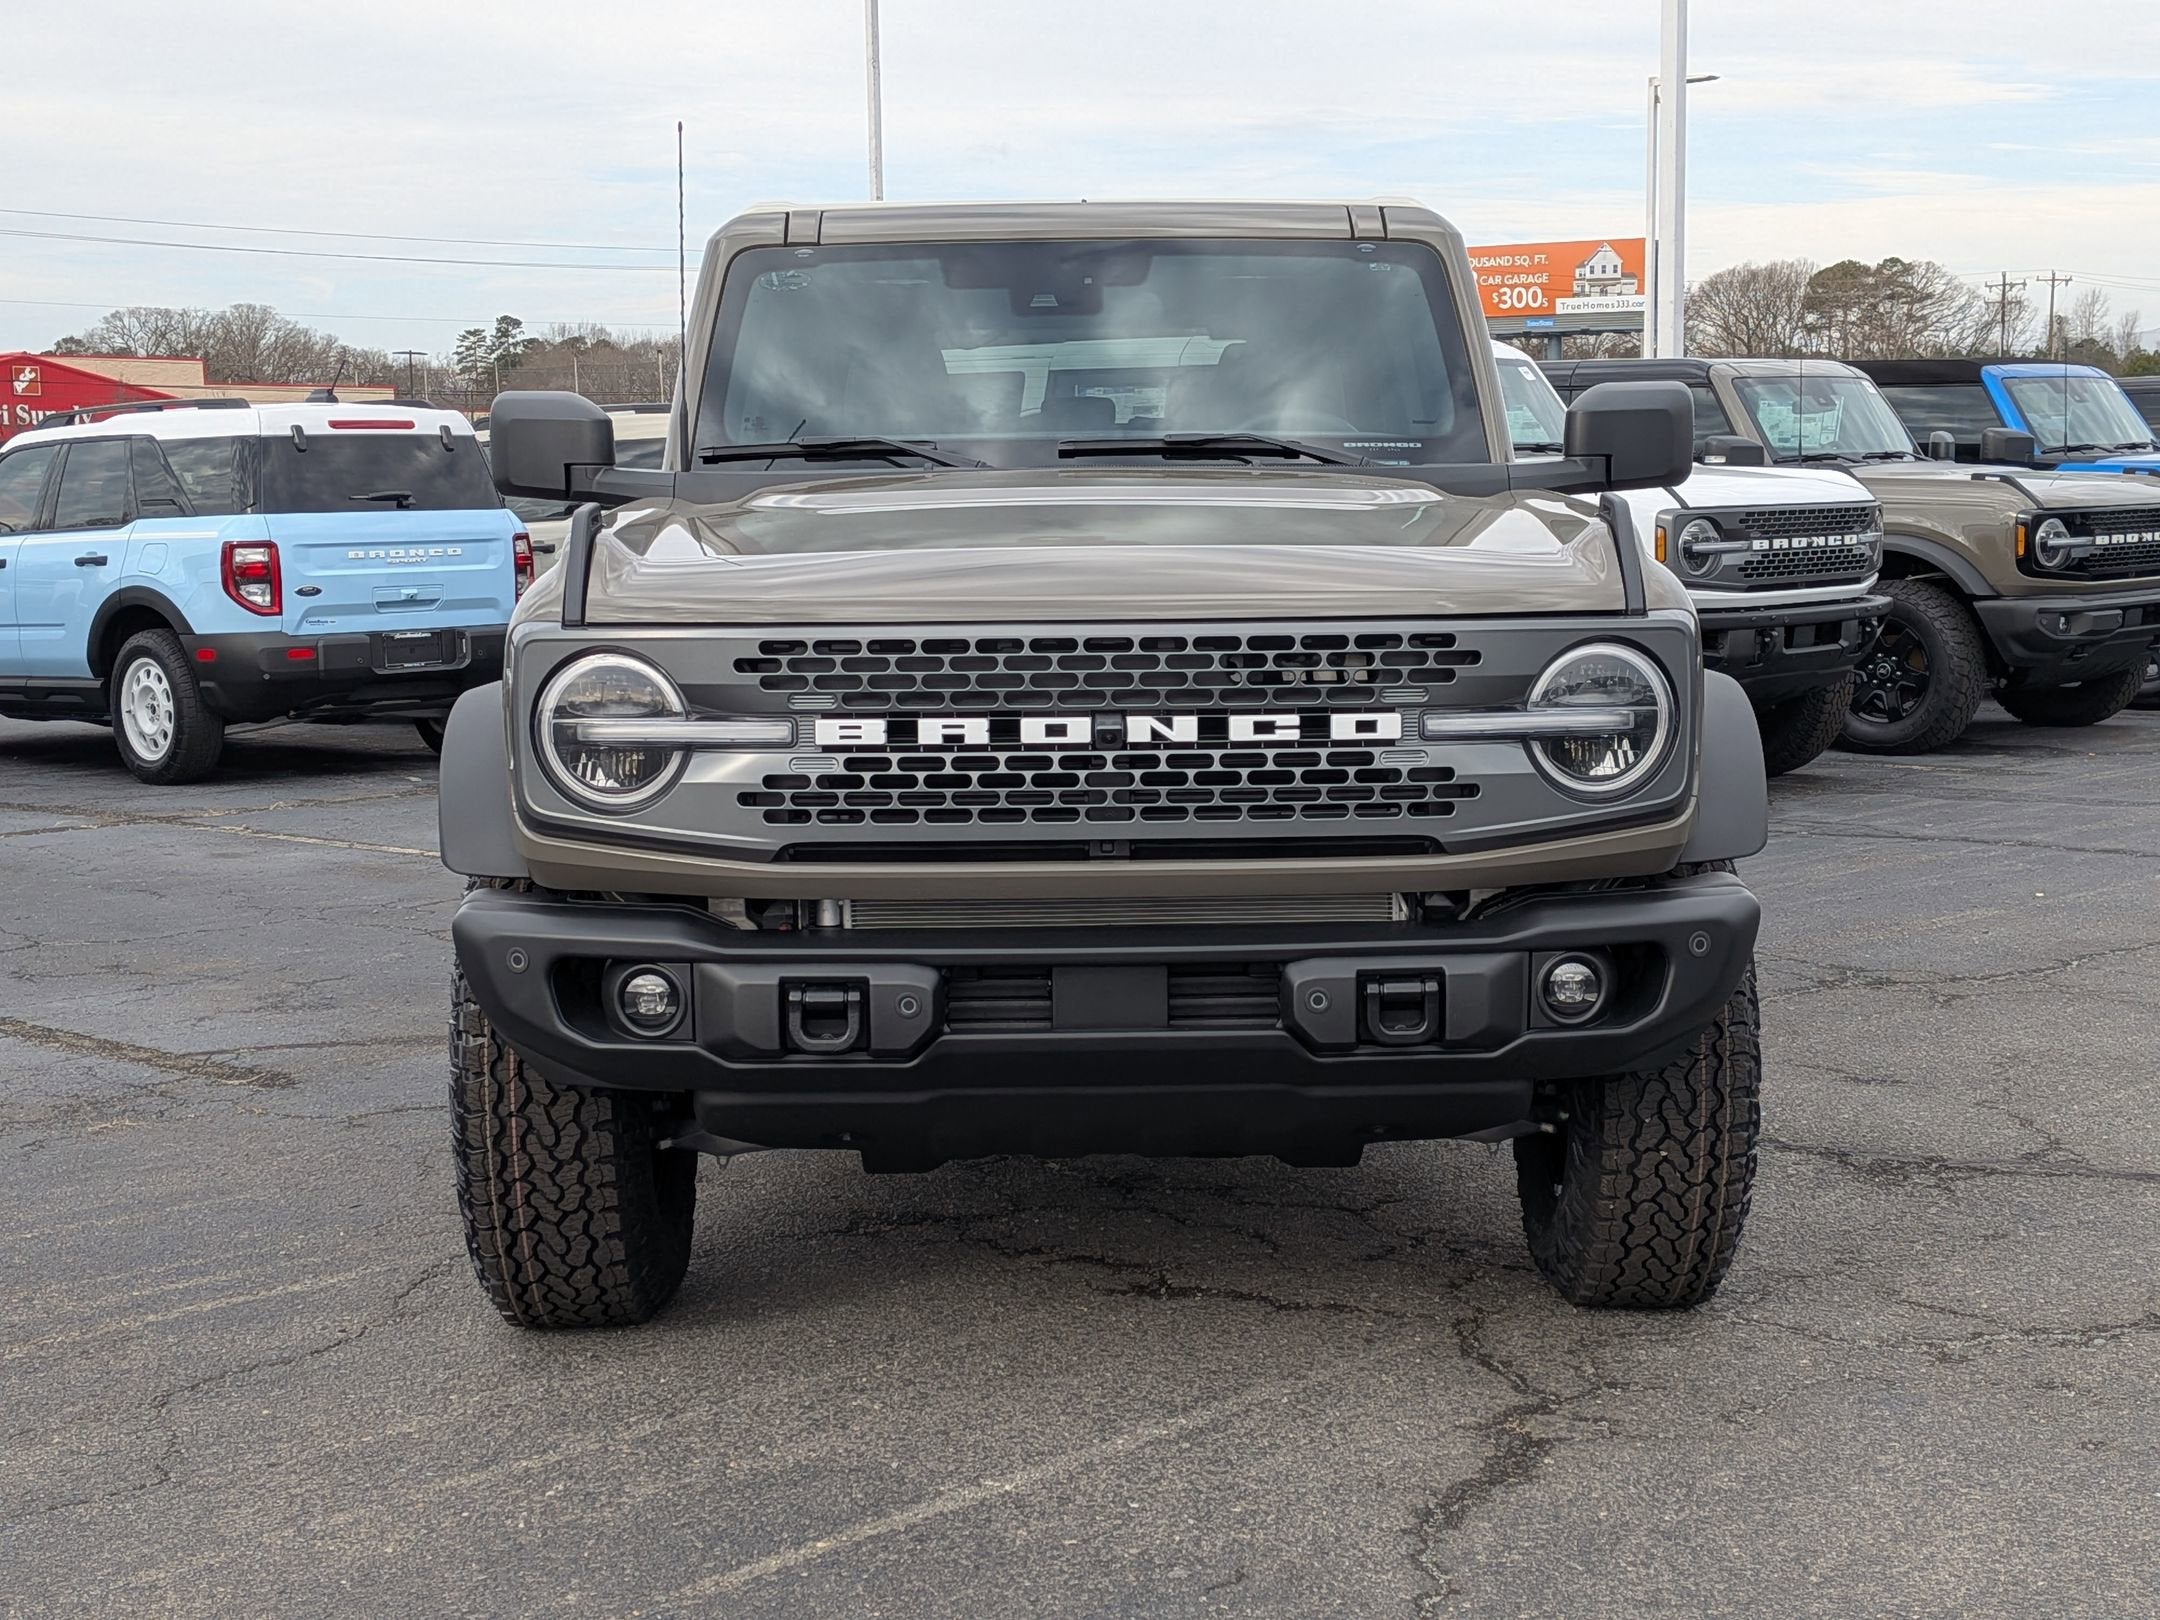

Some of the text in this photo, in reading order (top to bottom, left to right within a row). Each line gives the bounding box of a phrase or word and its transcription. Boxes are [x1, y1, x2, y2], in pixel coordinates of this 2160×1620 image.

[1514, 255, 1532, 267] SQ.
[1534, 254, 1549, 264] FT.
[1480, 275, 1502, 285] CAR
[1504, 273, 1549, 284] GARAGE
[1752, 534, 1858, 551] BRONCO
[348, 547, 462, 559] BRONCO
[814, 712, 1402, 746] BRONCO
